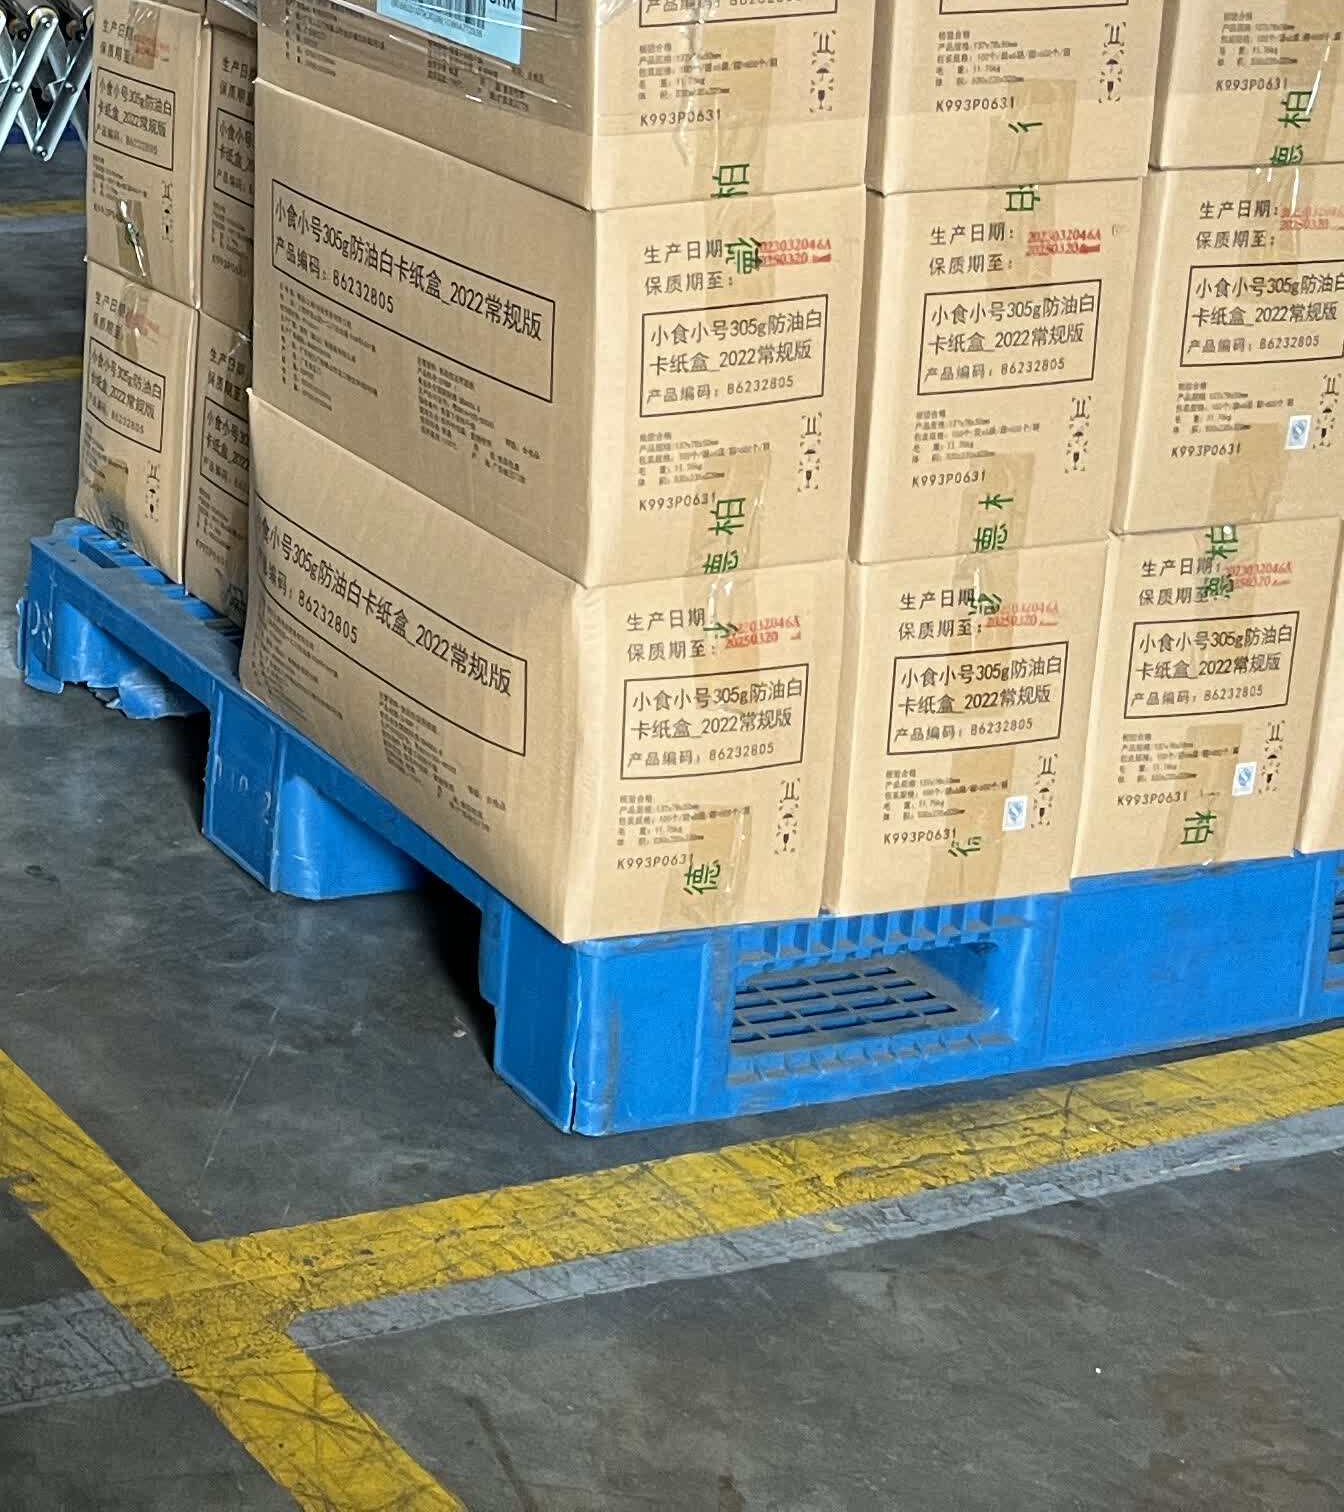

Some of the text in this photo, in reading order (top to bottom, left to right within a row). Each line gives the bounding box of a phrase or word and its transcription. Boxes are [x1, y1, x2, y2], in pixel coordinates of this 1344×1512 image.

[1216, 78, 1288, 92] K993P0631
[936, 96, 1014, 112] K993P0631
[640, 109, 722, 127] K993P0631
[1199, 199, 1278, 220] 生产日期：
[930, 222, 1014, 246] 生产日期：
[1196, 230, 1275, 250] 保质期至：
[274, 202, 543, 341] 小食小号305g防油白卡纸盒_2022常规版
[275, 236, 394, 314] 产品编码：86232805
[929, 254, 1013, 276] 保质期至：
[645, 271, 733, 296] 保质期至：
[931, 293, 1095, 326] 小食小号305g防油白
[1192, 301, 1338, 327] 卡纸盒_2022常规版
[651, 309, 822, 347] 小食小号305g防油白
[928, 323, 1085, 355] 卡纸盒_2022常规版
[650, 339, 812, 376] 卡纸盒_2022常规版
[924, 357, 1065, 383] 产品编码：86232805
[646, 376, 794, 405] 产品编码：86232805
[1171, 443, 1241, 458] K993P0631
[912, 469, 986, 488] K993P0631
[639, 492, 716, 511] K993P0631
[898, 619, 982, 640] 保质期至：
[1139, 624, 1292, 654] 小食小号305g防油白
[628, 639, 718, 662] 保质期至：
[901, 656, 1062, 688] 小食小号305g防油白
[1136, 652, 1282, 681] 卡纸盒_2022常规版
[632, 678, 803, 712] 小食小号305g防油白
[898, 684, 1051, 716] 卡纸盒_2022常规版
[631, 708, 792, 740] 卡纸盒_2022常规版
[628, 743, 774, 767] 产品编码：86232805
[1117, 791, 1187, 806] K993P0631
[884, 828, 956, 845] K993P0631
[617, 853, 694, 870] K993P0631
